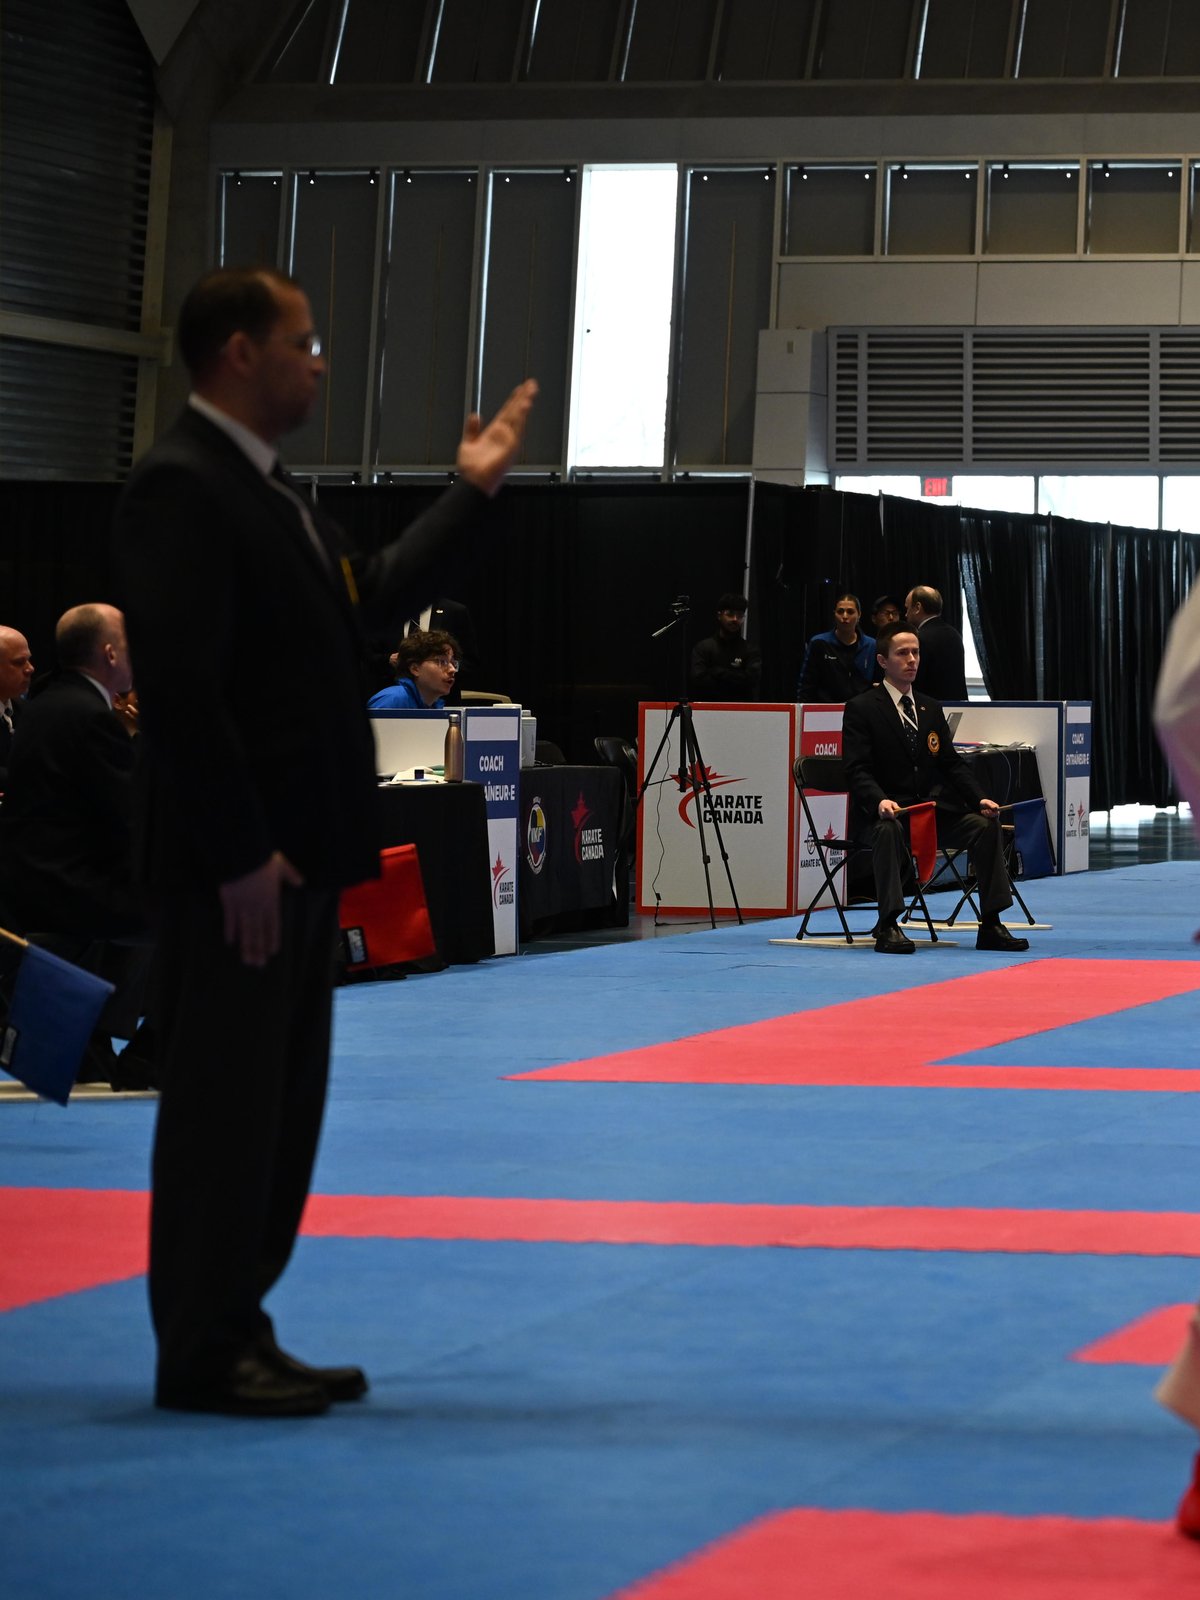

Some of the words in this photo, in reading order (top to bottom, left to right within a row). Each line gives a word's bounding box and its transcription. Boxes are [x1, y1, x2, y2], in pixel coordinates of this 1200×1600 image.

[925, 478, 947, 496] EXIT
[814, 743, 837, 755] COACH
[479, 755, 504, 772] COACH
[703, 795, 762, 809] KARATE
[703, 810, 763, 824] CANADA
[581, 829, 603, 845] KARATE
[581, 845, 605, 861] CANADA
[800, 859, 815, 868] KARATE
[499, 882, 514, 894] KARATE
[499, 894, 514, 906] CANADA
